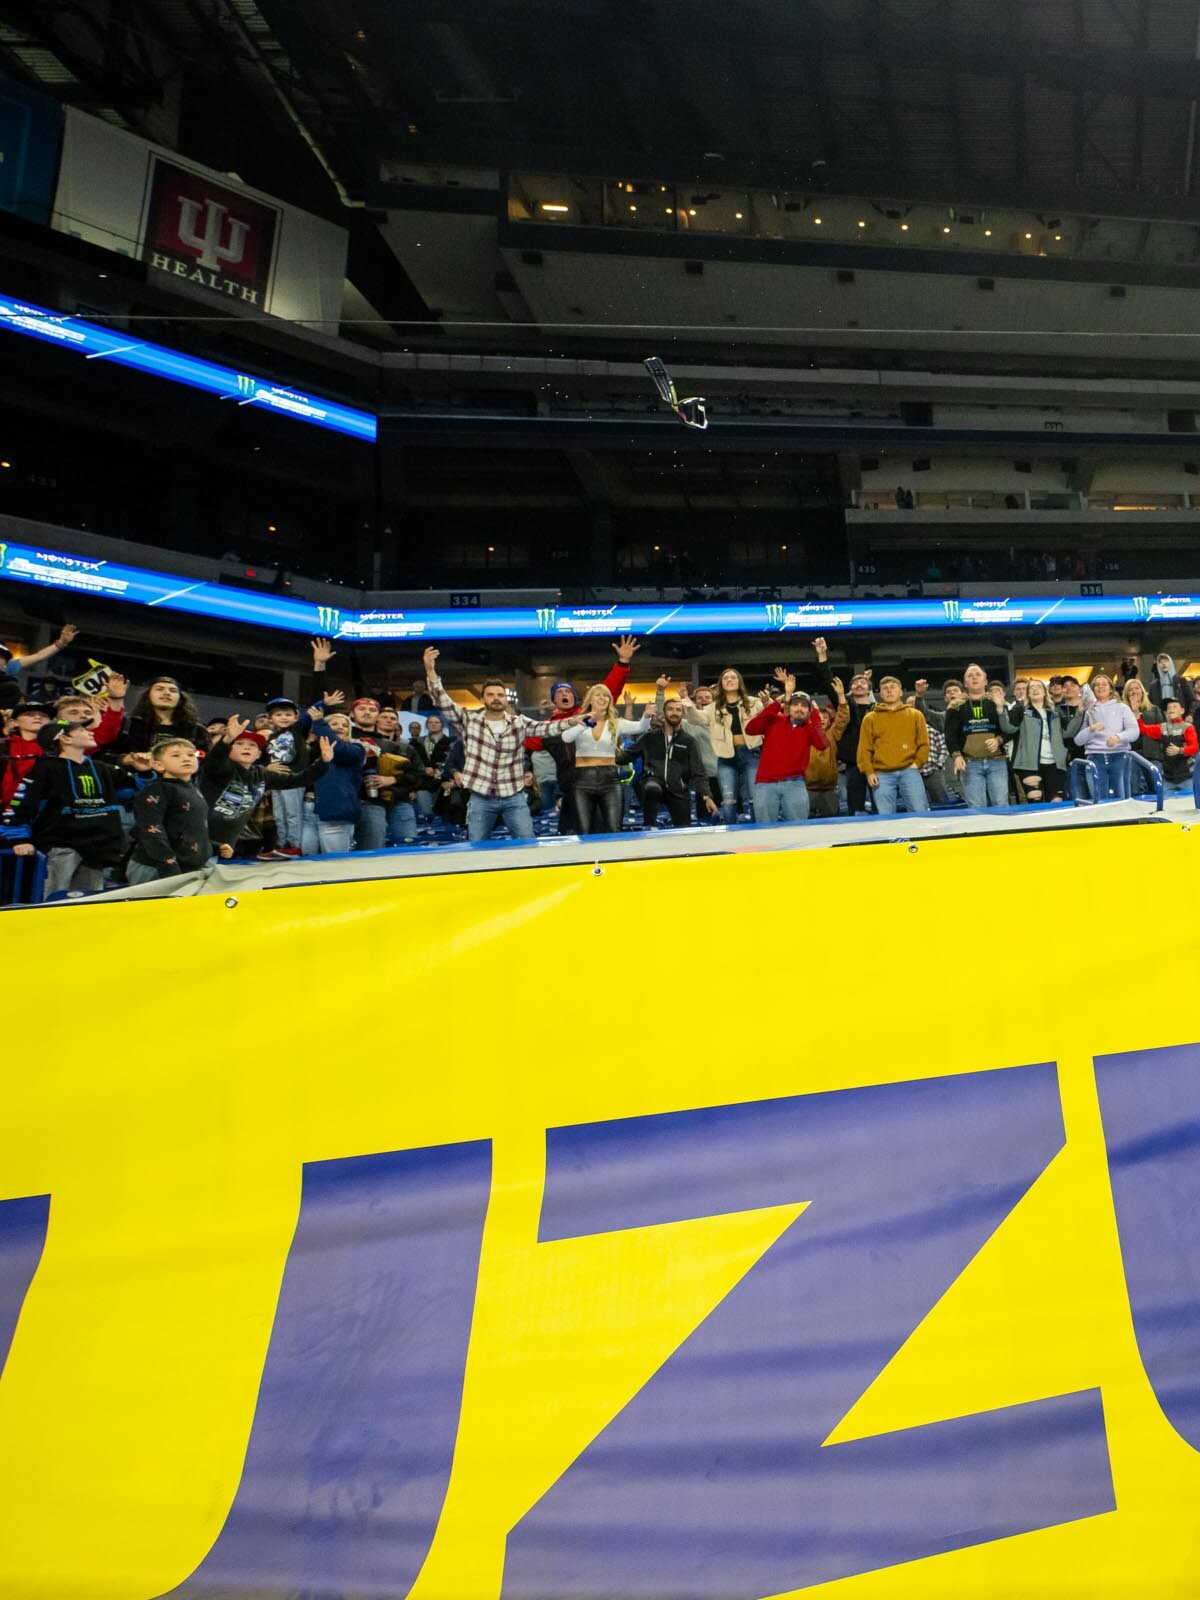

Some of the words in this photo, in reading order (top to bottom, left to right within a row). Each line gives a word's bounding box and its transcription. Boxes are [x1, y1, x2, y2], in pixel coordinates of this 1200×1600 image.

[151, 252, 258, 304] HEALTH
[36, 552, 99, 571] MONSTER
[452, 595, 480, 606] 334
[83, 670, 109, 695] 94
